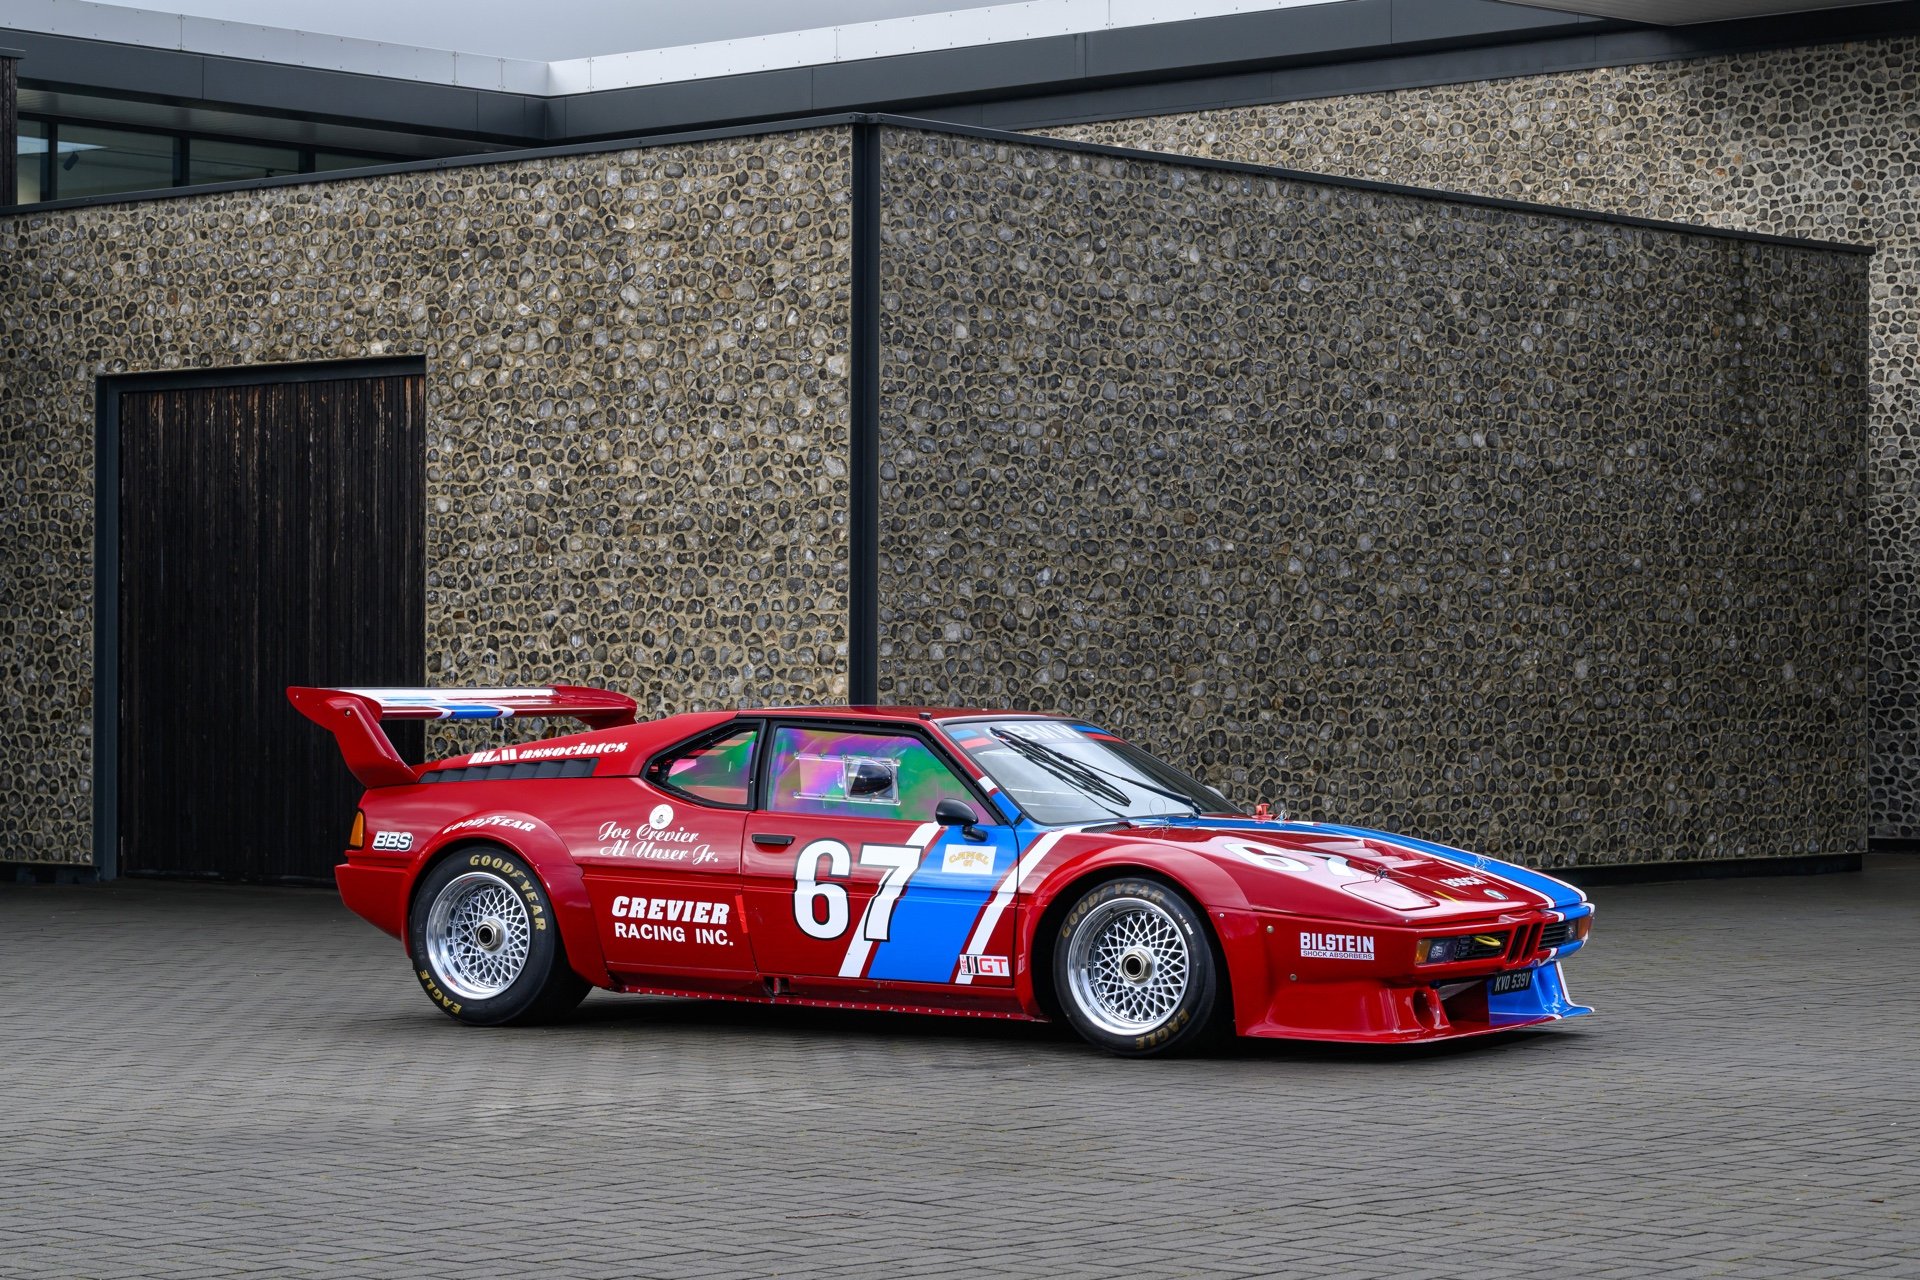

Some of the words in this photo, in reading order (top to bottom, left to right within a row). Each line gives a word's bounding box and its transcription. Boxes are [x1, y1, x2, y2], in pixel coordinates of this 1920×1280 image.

[1001, 724, 1085, 740] BMW
[518, 742, 629, 759] associates
[442, 815, 537, 834] GOODYEAR
[598, 821, 632, 842] Joe
[636, 823, 700, 843] Crevier
[372, 831, 413, 851] BBS
[599, 840, 630, 857] Al
[632, 841, 689, 861] Unser
[692, 844, 719, 865] Jr.
[469, 854, 547, 931] GOODYEAR
[792, 837, 924, 942] 67
[611, 895, 730, 925] CREVIER
[1062, 882, 1166, 939] GOODYEAR
[614, 922, 686, 943] RACING
[695, 928, 734, 946] INC.
[1300, 932, 1374, 952] BILSTEIN
[979, 958, 1007, 973] GT
[1329, 951, 1373, 960] ABSORBERS
[419, 969, 462, 1014] EAGLE
[1135, 1007, 1190, 1049] EAGLE
